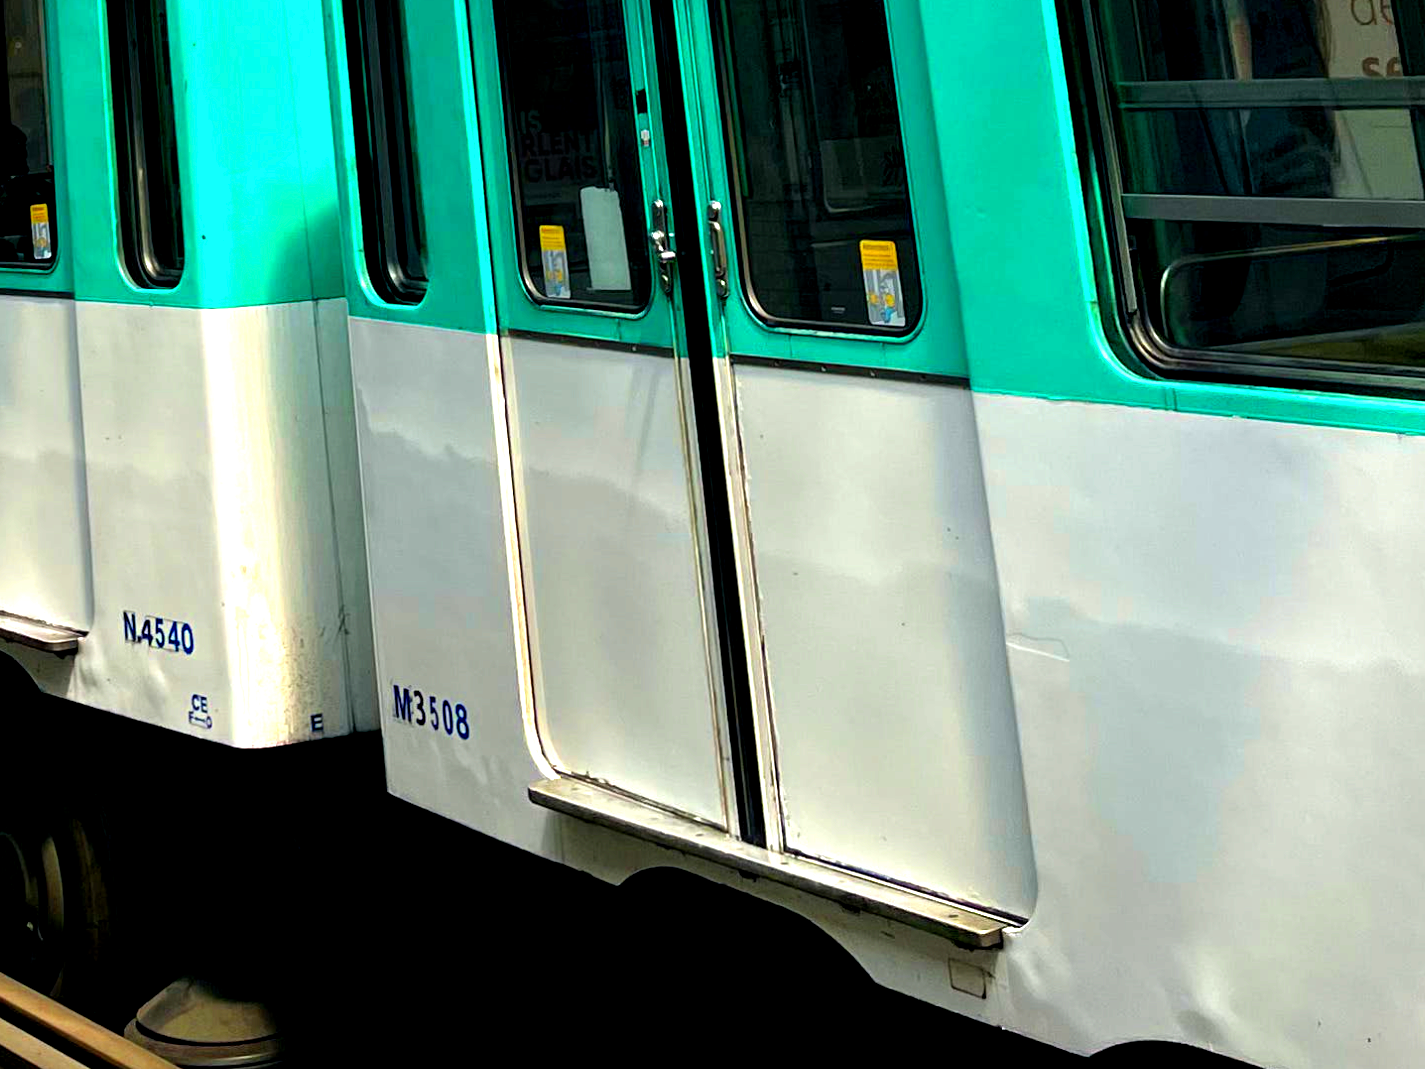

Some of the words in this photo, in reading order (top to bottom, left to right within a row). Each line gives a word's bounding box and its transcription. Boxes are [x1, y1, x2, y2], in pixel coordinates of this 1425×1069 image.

[191, 694, 208, 713] CE
[393, 684, 470, 741] M3508
[310, 714, 323, 731] E
